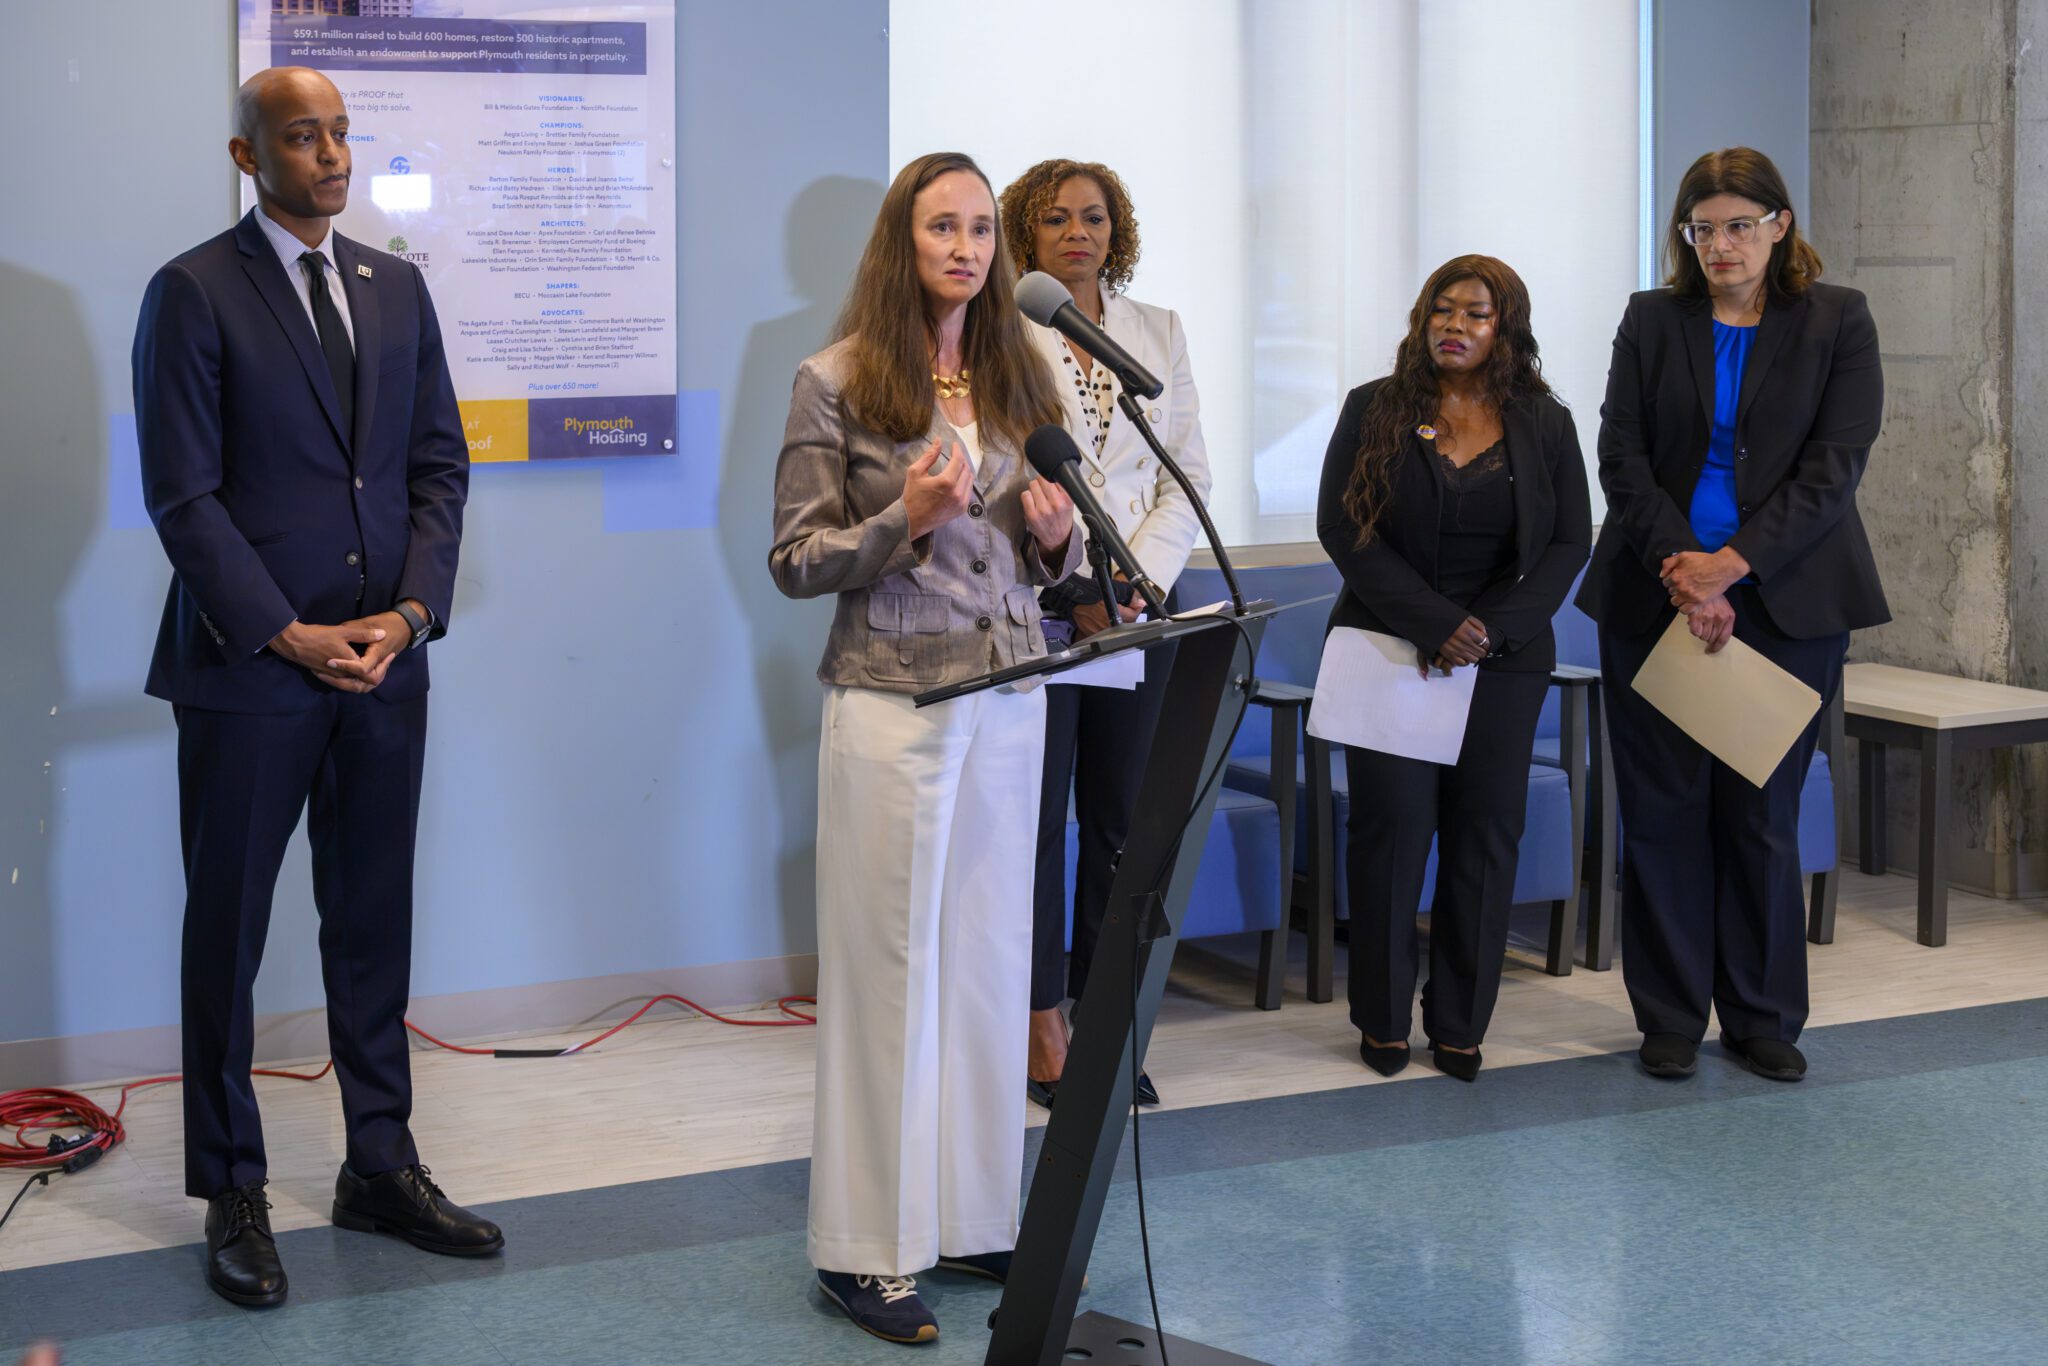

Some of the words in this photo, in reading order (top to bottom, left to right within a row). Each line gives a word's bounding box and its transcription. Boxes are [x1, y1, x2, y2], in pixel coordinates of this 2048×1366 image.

[294, 29, 318, 39] $59.1
[321, 29, 353, 39] million
[356, 31, 384, 40] raised
[399, 31, 421, 40] build
[424, 32, 442, 40] 600
[445, 32, 478, 42] homes,
[516, 34, 534, 42] 500
[536, 34, 569, 43] historic
[572, 36, 625, 45] apartments,
[291, 47, 308, 55] and
[311, 47, 353, 56] establish
[370, 48, 426, 58] endowment
[441, 51, 476, 60] support
[479, 50, 523, 60] Plymouth
[526, 51, 567, 60] residents
[580, 52, 628, 62] perpetuity.
[367, 104, 378, 112] big
[399, 253, 429, 261] COTE
[564, 416, 633, 436] Plymouth
[467, 435, 492, 450] oof
[590, 430, 647, 446] Housing
